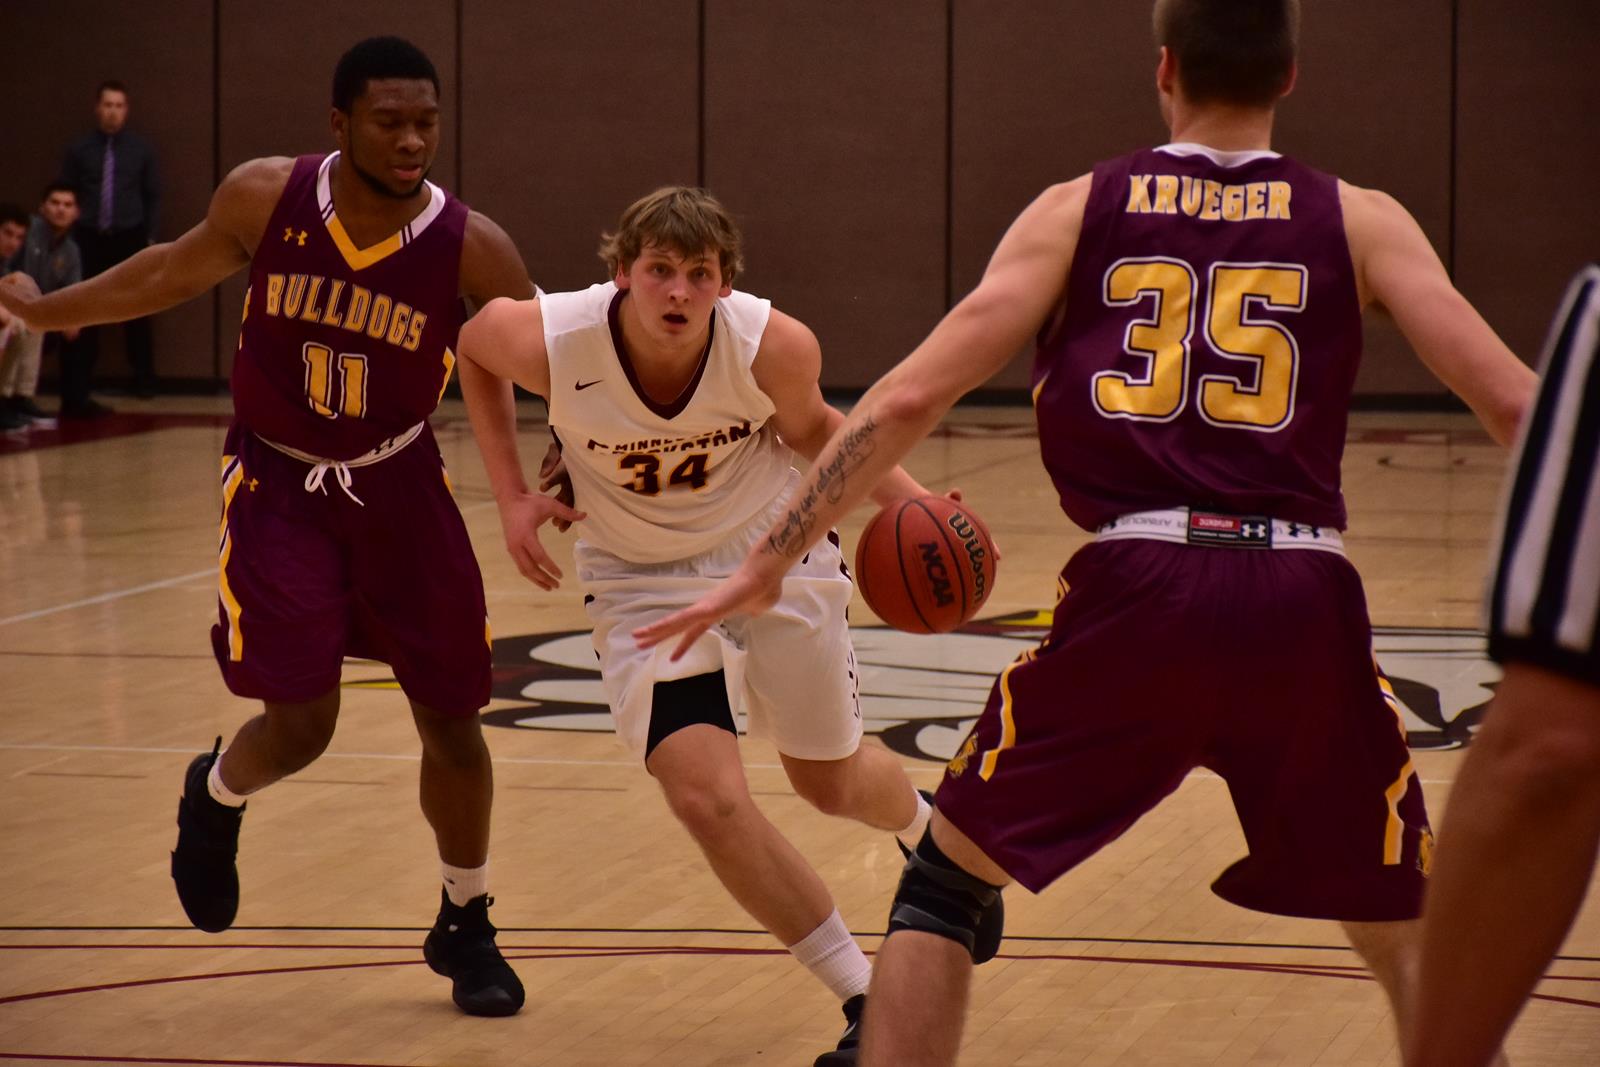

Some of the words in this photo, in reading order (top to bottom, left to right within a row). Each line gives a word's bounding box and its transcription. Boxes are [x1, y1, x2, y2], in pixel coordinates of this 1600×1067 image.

[1125, 174, 1292, 222] KRUEGER
[265, 273, 427, 352] BULLDOGS
[1091, 255, 1309, 433] 35
[302, 341, 368, 419] 11
[617, 451, 711, 497] 34
[918, 541, 956, 608] NCAA
[947, 512, 986, 604] Wilson
